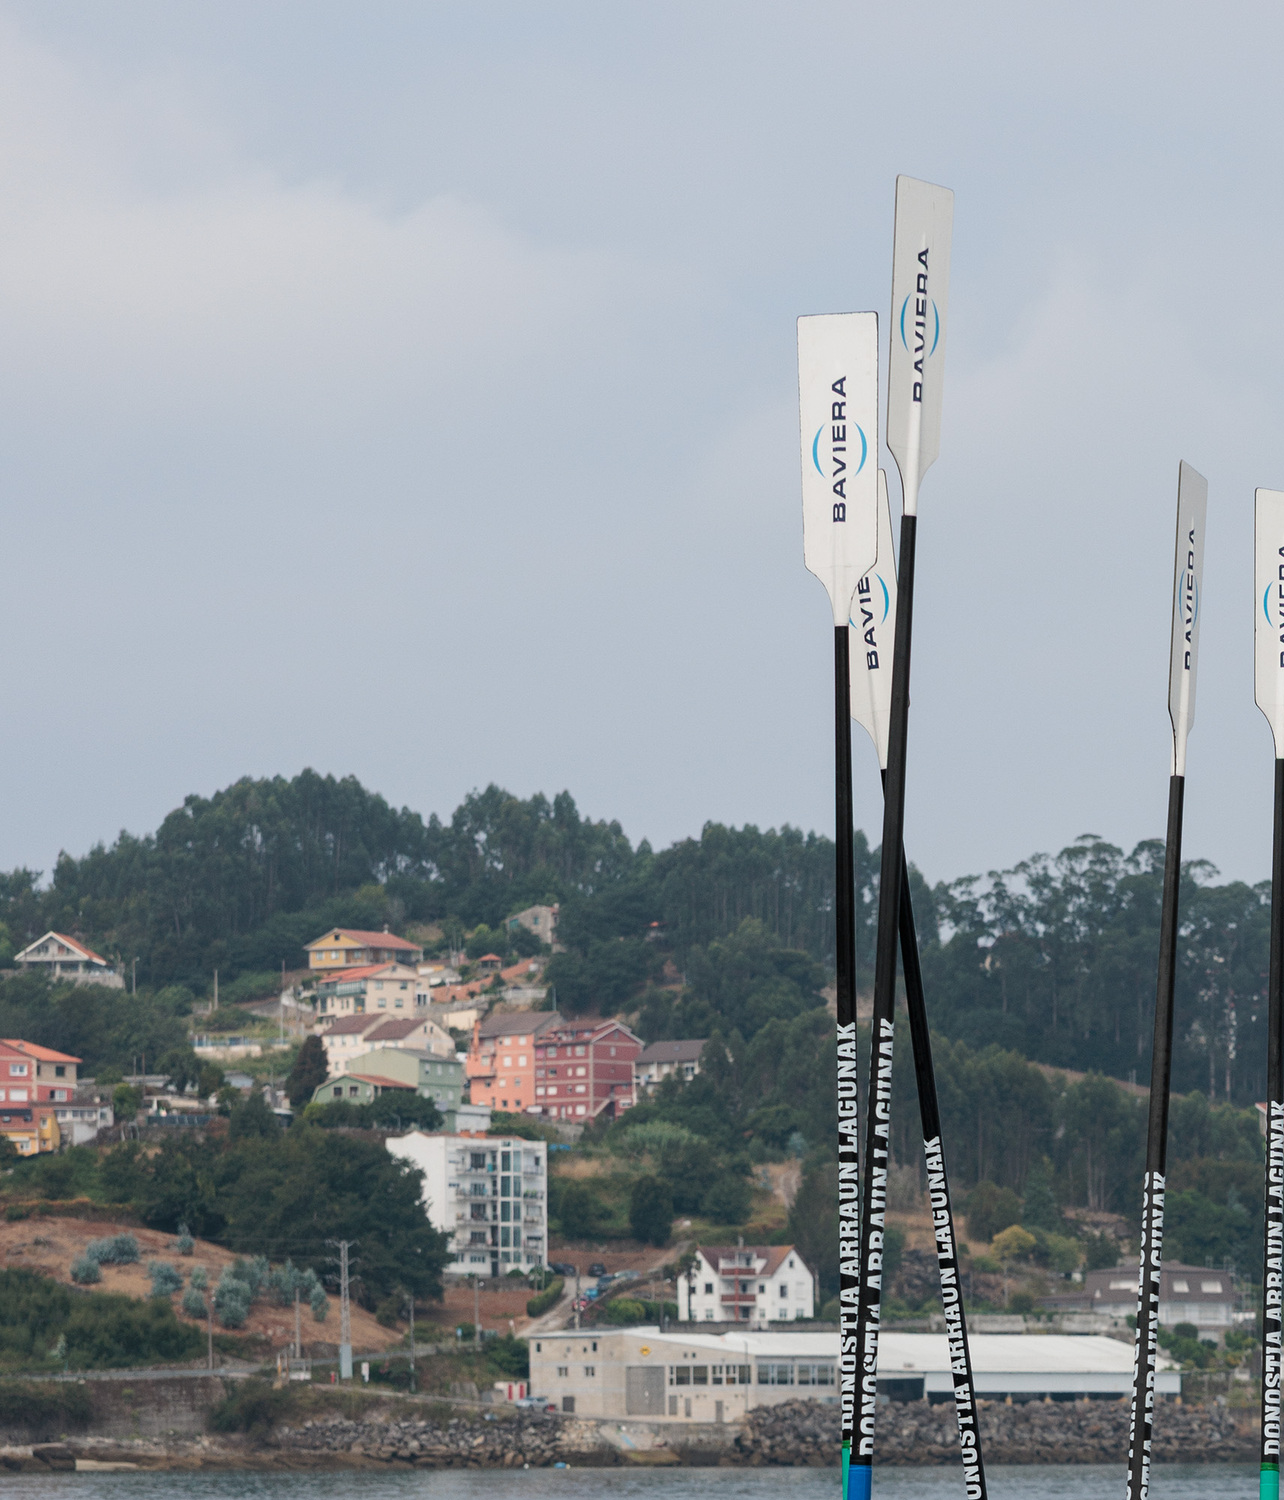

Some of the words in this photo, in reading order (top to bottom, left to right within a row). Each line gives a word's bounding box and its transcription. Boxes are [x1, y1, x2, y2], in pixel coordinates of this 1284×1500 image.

[831, 374, 848, 524] BAVIERA
[837, 1021, 858, 1154] LAGUNAK
[839, 1161, 859, 1277] ARRAUN
[923, 1135, 954, 1260] LAGUNAK
[939, 1267, 967, 1376] ARRAUN
[1266, 1221, 1283, 1320] ARRAUN
[1264, 1331, 1281, 1456] DONOSTIA
